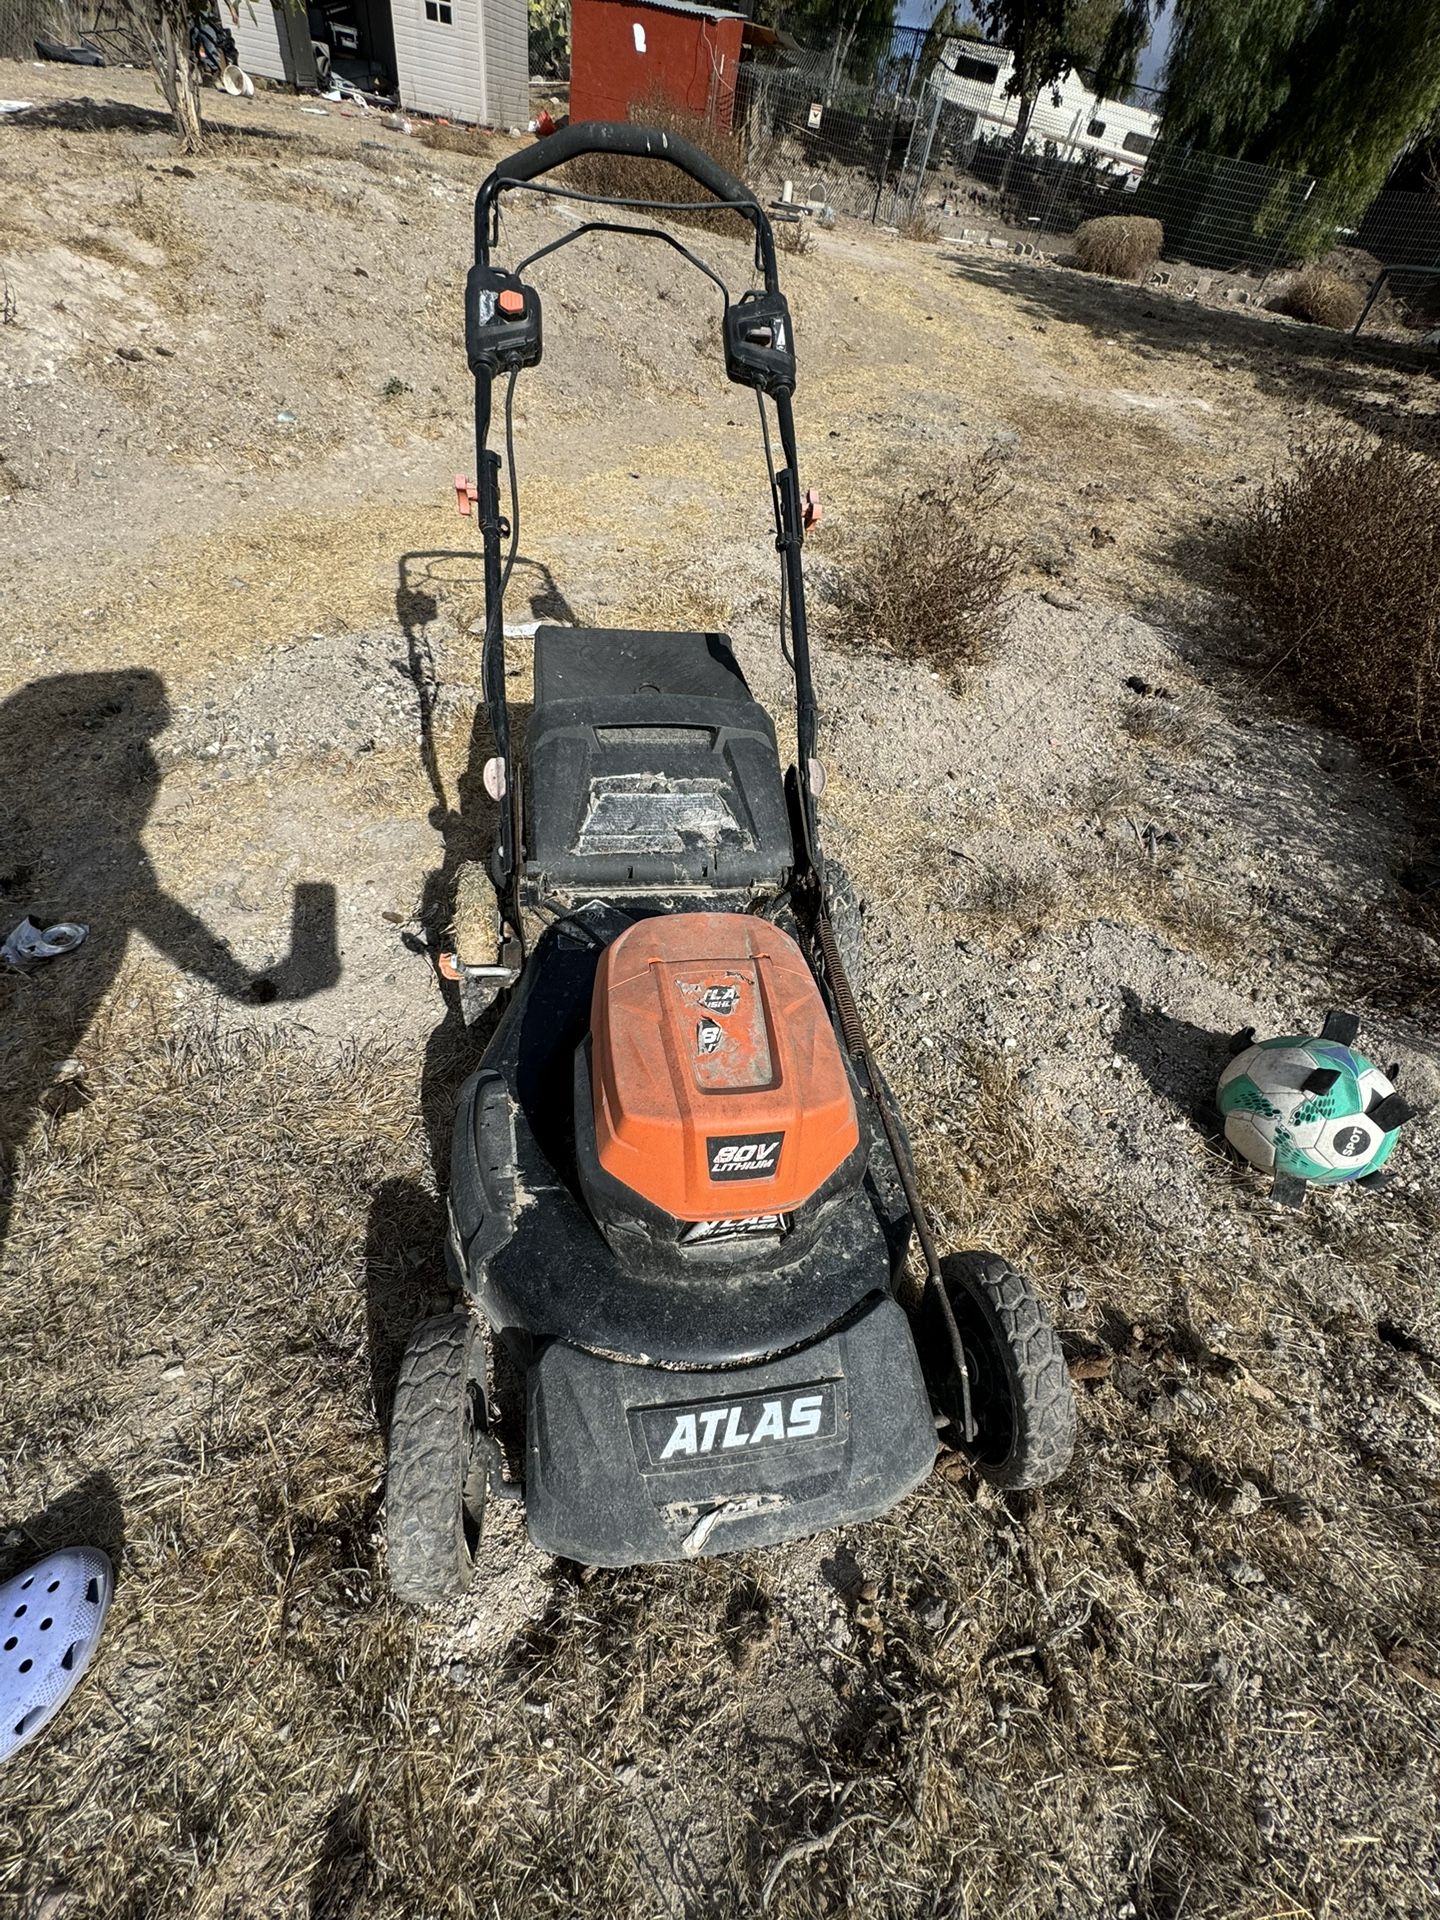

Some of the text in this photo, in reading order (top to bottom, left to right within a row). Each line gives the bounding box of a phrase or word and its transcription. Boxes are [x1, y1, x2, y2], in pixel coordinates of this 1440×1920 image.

[713, 1141, 780, 1163] 80V
[1341, 1127, 1363, 1156] SPOT
[711, 1159, 775, 1172] LITHIUM
[660, 1395, 823, 1459] ATLAS
